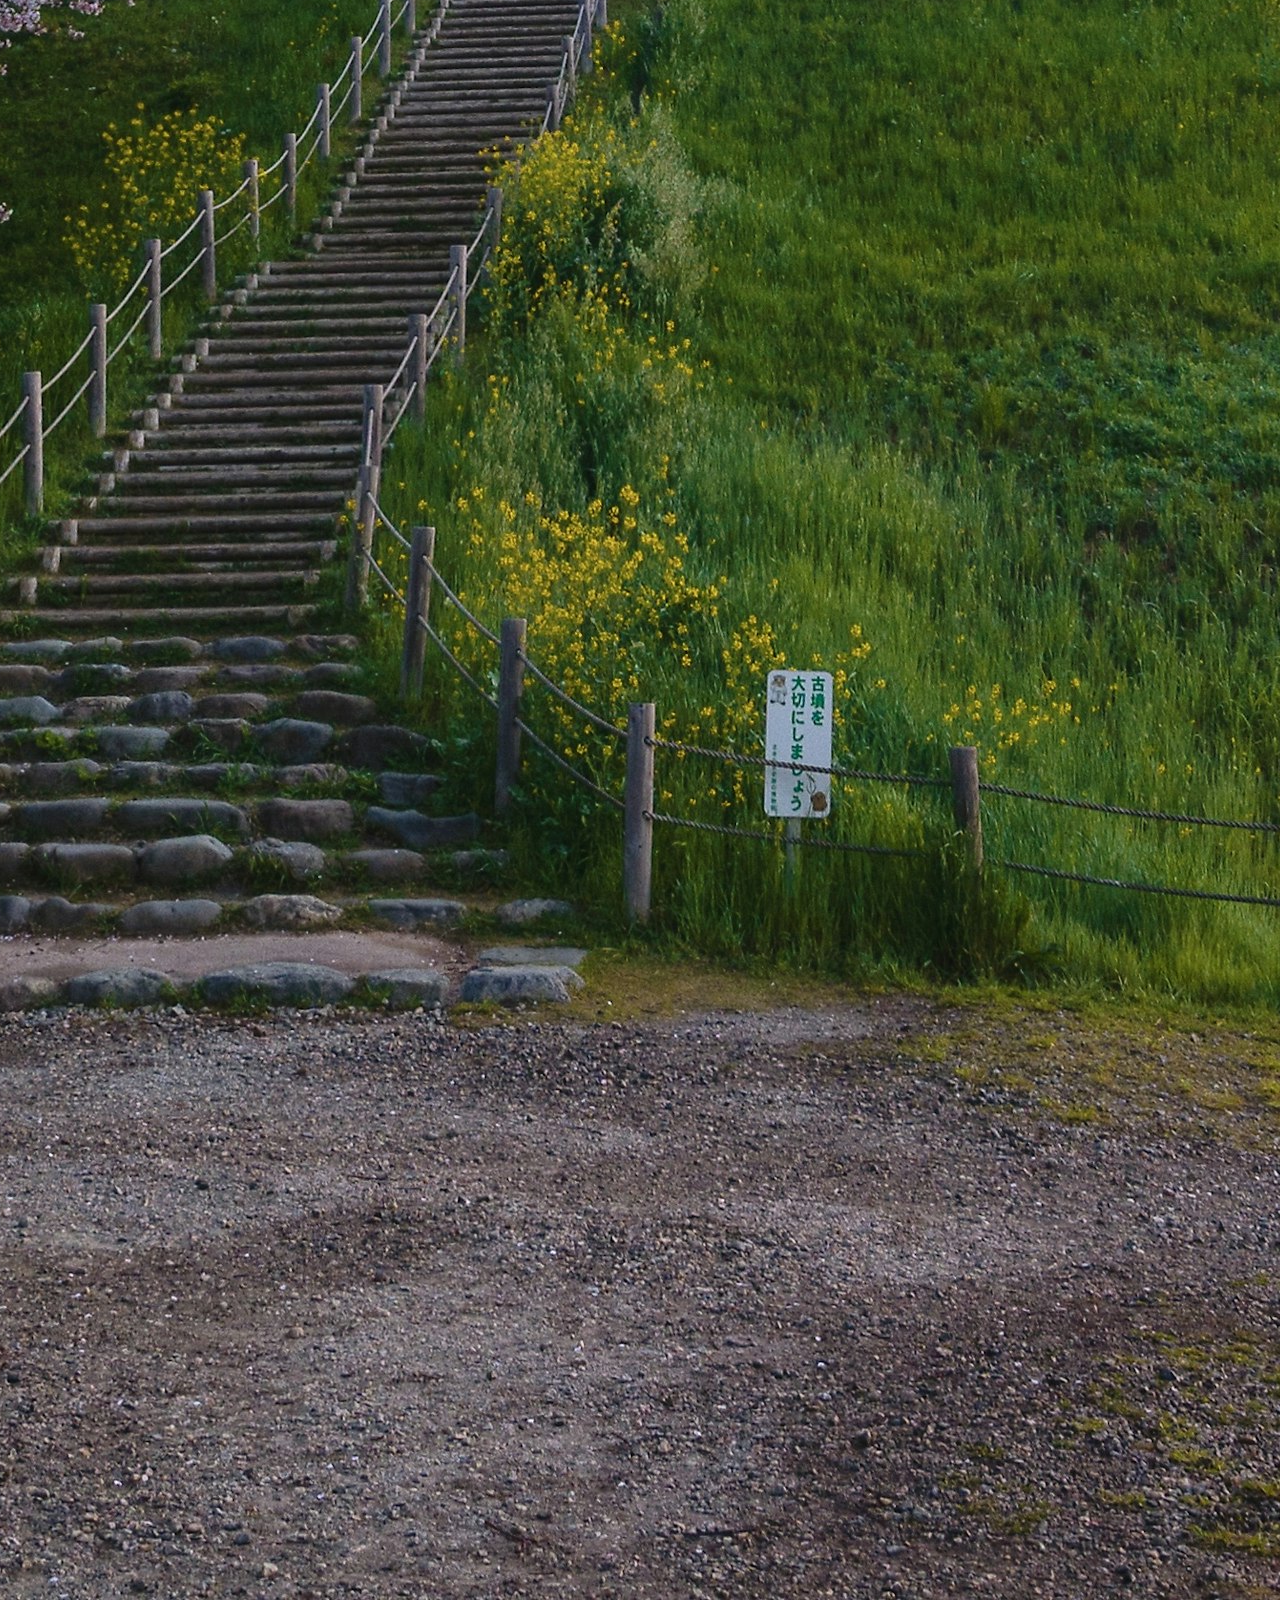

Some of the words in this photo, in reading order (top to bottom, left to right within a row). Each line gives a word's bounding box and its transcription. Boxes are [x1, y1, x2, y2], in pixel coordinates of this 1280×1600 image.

[791, 675, 805, 811] 大切にしましょう
[811, 676, 825, 726] 古墳を
